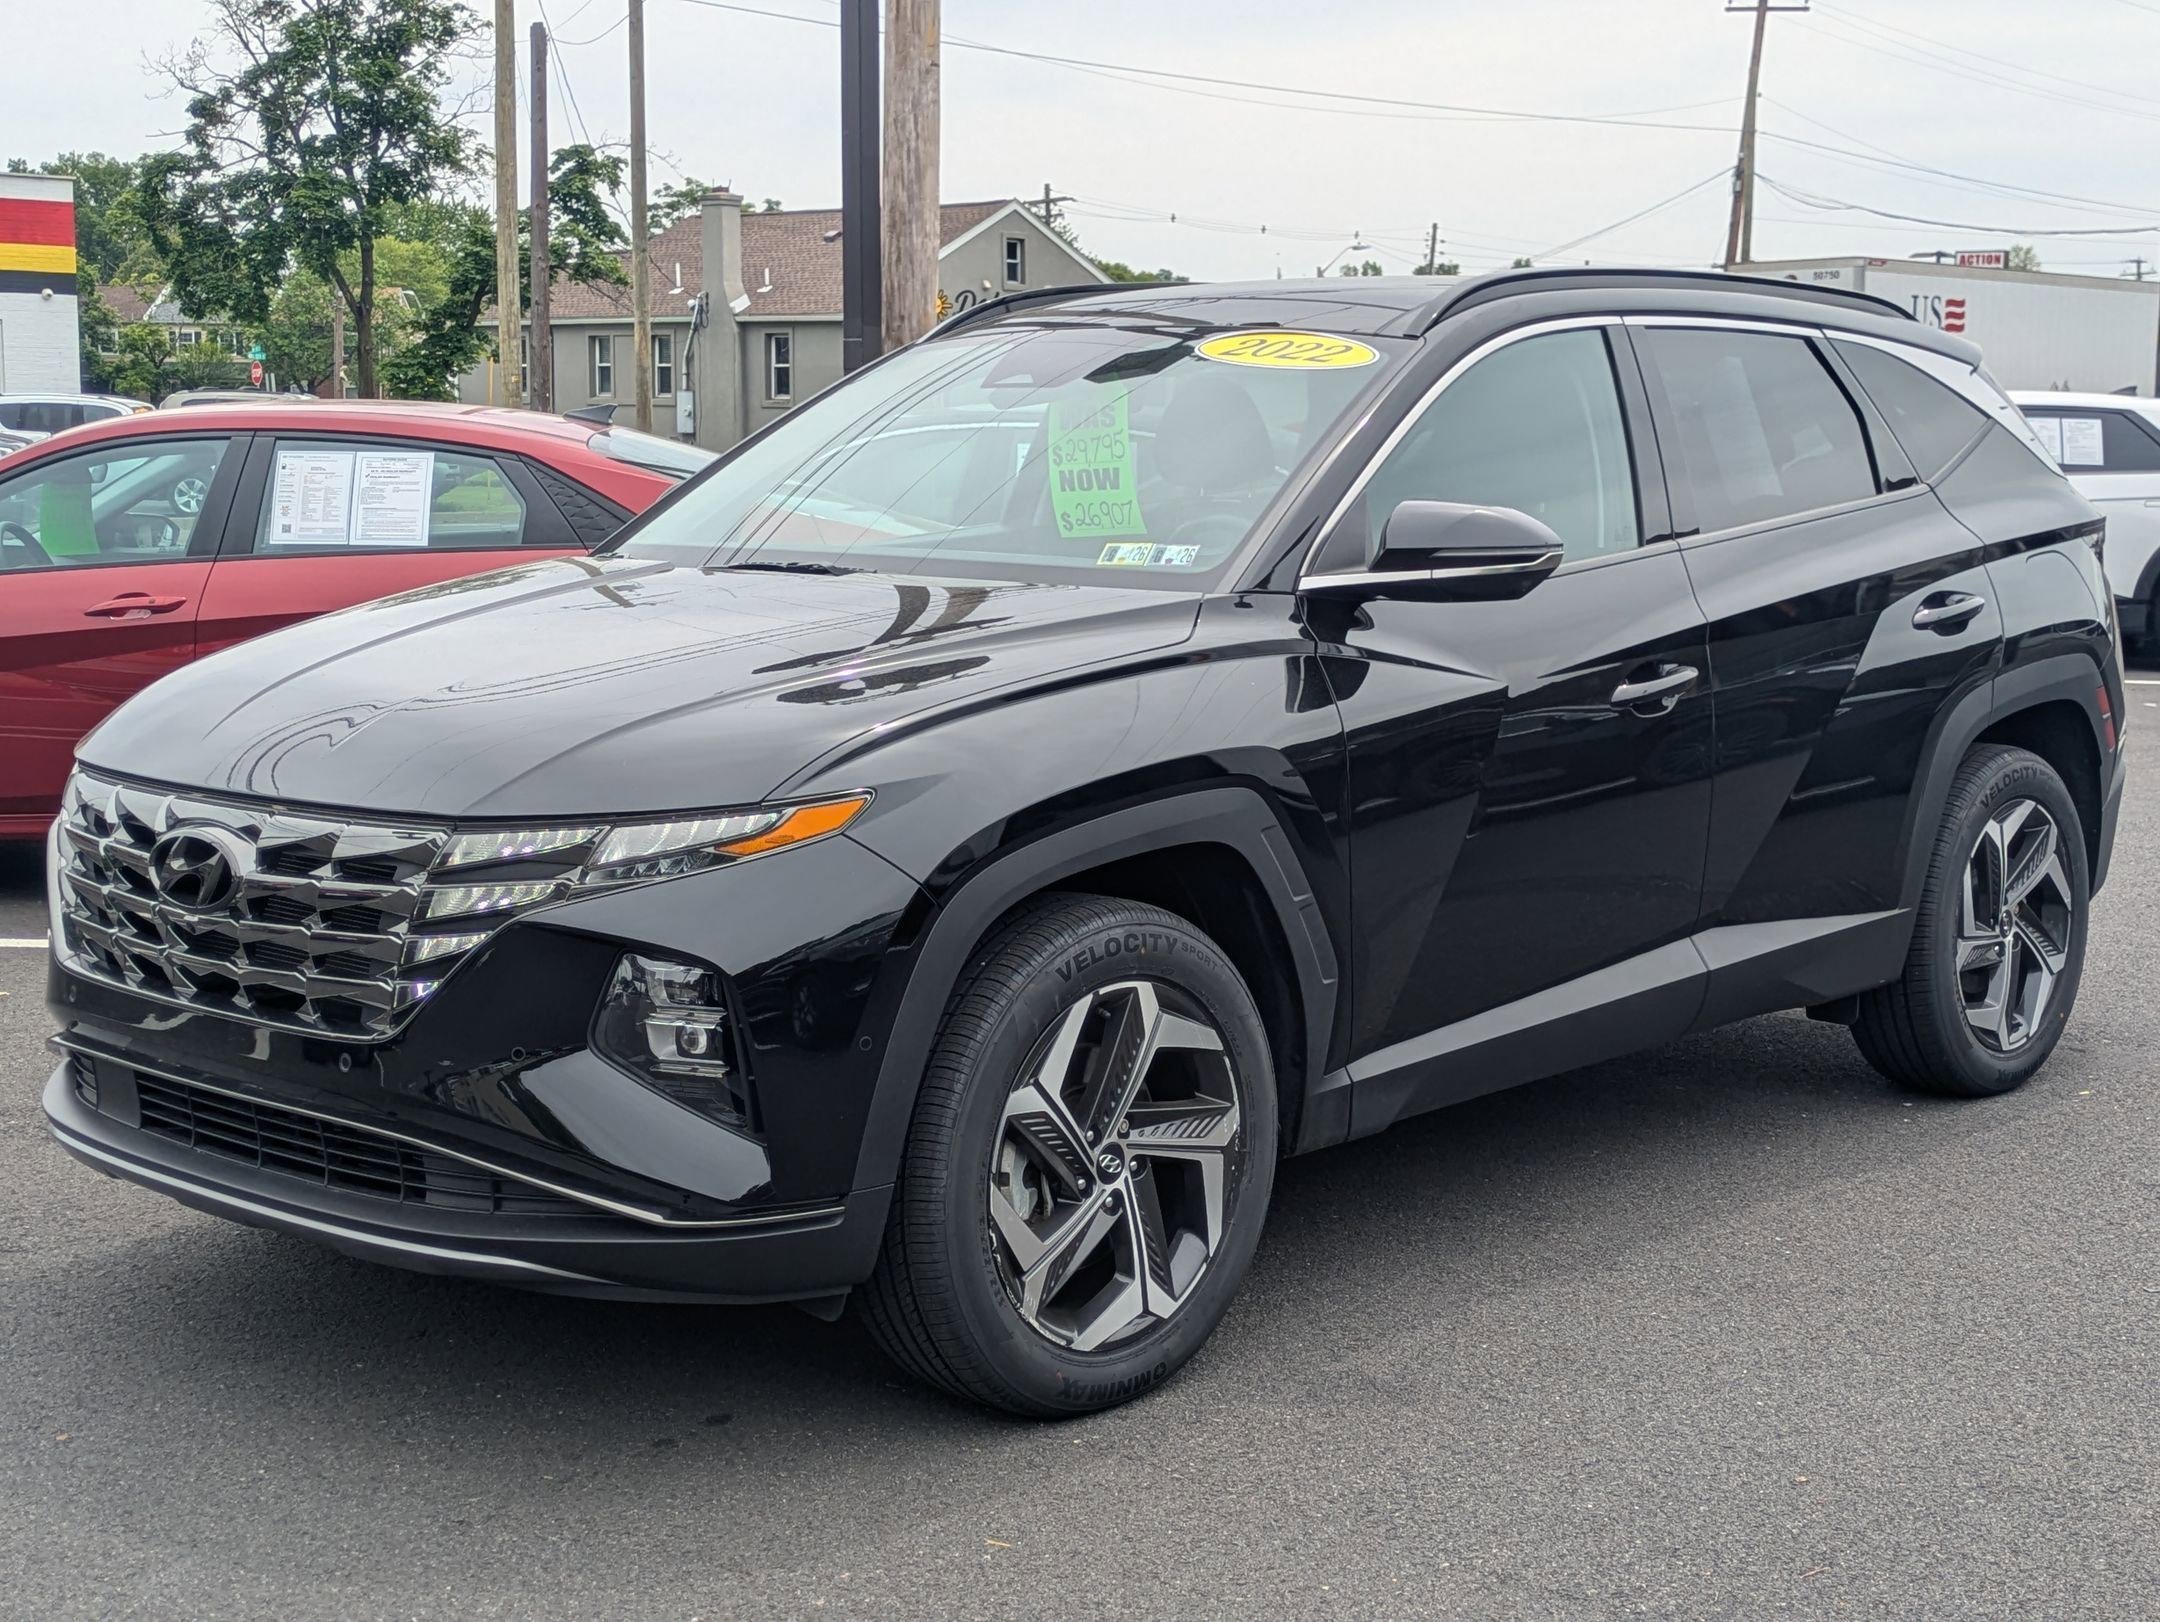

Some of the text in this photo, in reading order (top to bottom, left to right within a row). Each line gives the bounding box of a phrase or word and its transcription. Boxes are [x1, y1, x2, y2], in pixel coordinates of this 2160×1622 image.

[1959, 254, 2002, 267] ACTION
[1217, 338, 1353, 363] 2022
[1052, 429, 1126, 468] $29,795
[1058, 467, 1121, 493] NOW
[1060, 500, 1133, 532] $26,907
[1980, 766, 2039, 809] VELOCITY
[1054, 932, 1219, 984] VELOCITY SPORT
[1058, 1361, 1167, 1400] OMNIMAX
